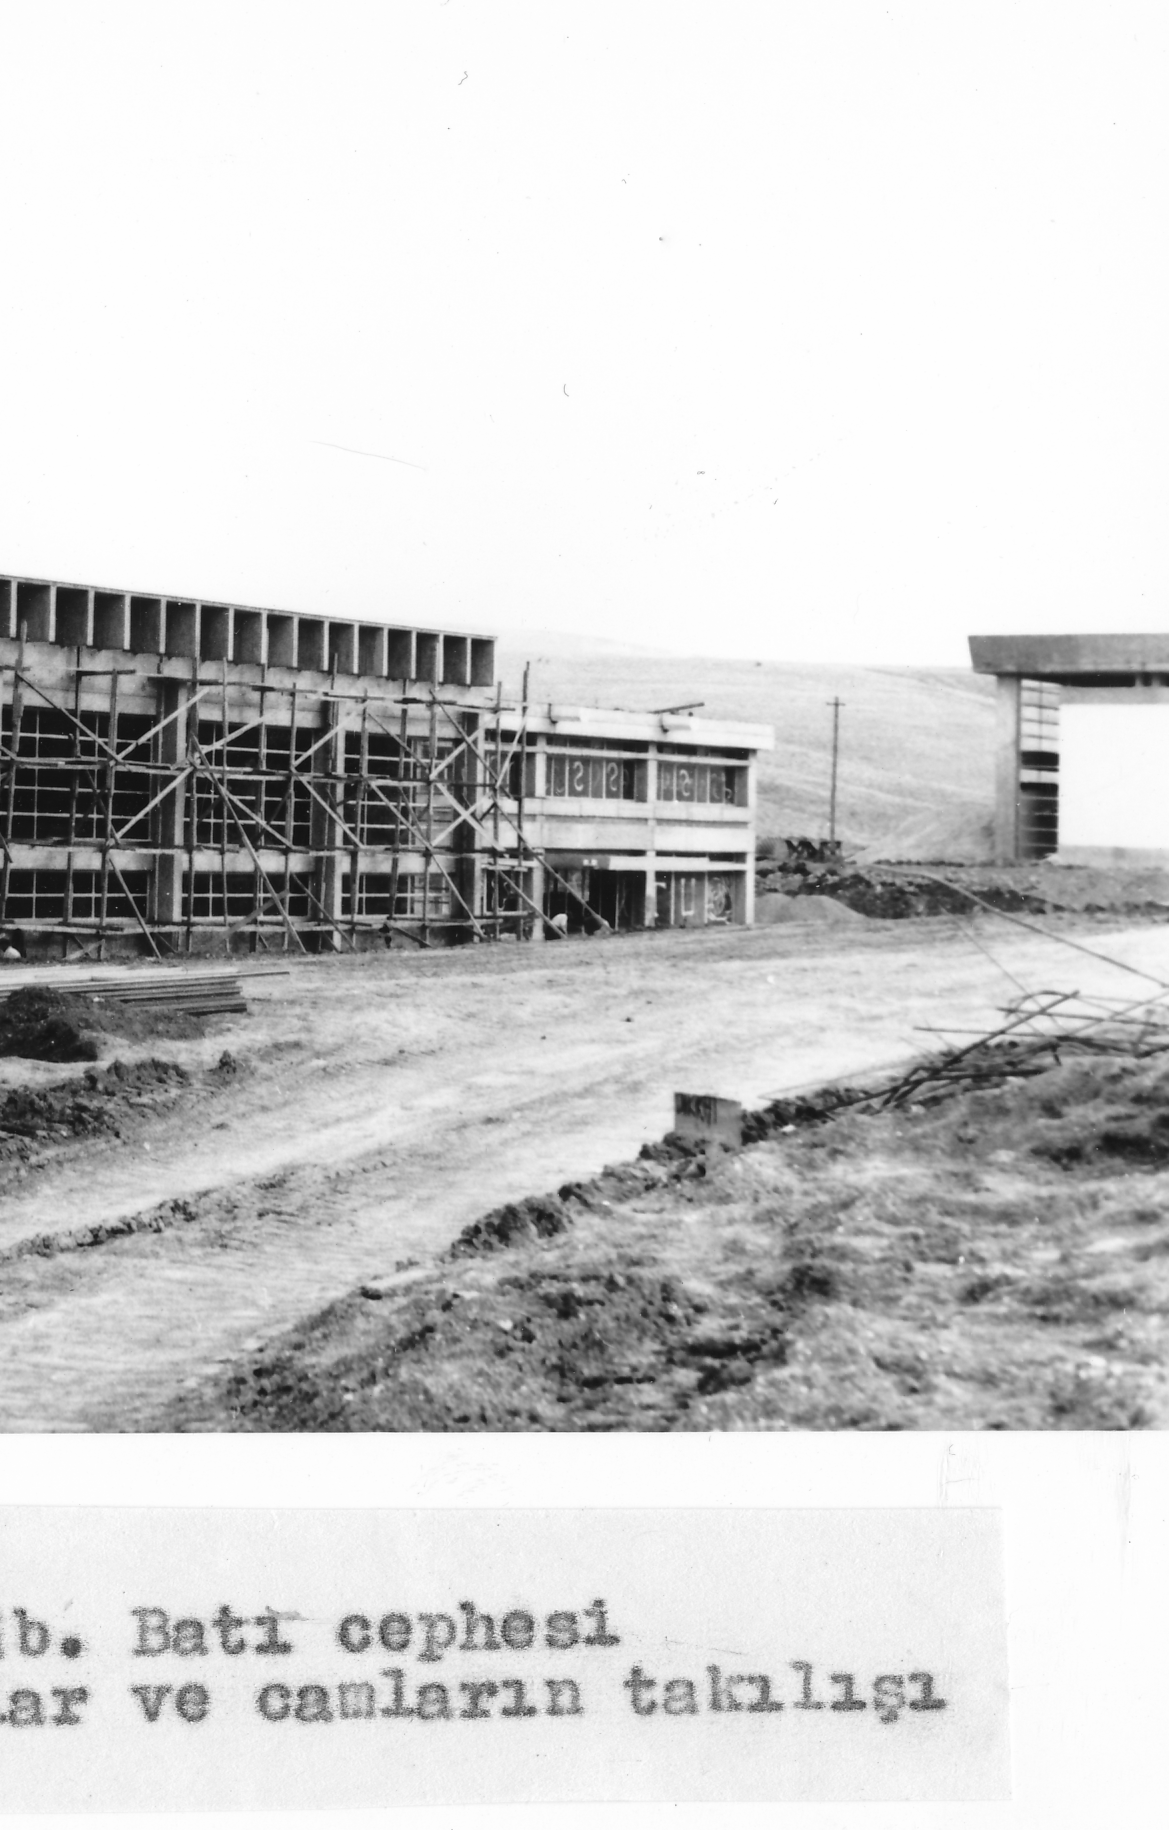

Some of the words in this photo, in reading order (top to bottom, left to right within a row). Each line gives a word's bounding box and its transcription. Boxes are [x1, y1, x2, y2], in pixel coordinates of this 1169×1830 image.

[130, 1603, 294, 1658] Batı
[334, 1598, 622, 1663] cephesi
[130, 1682, 211, 1724] ve
[254, 1668, 586, 1724] camların
[622, 1660, 948, 1725] takılışı
